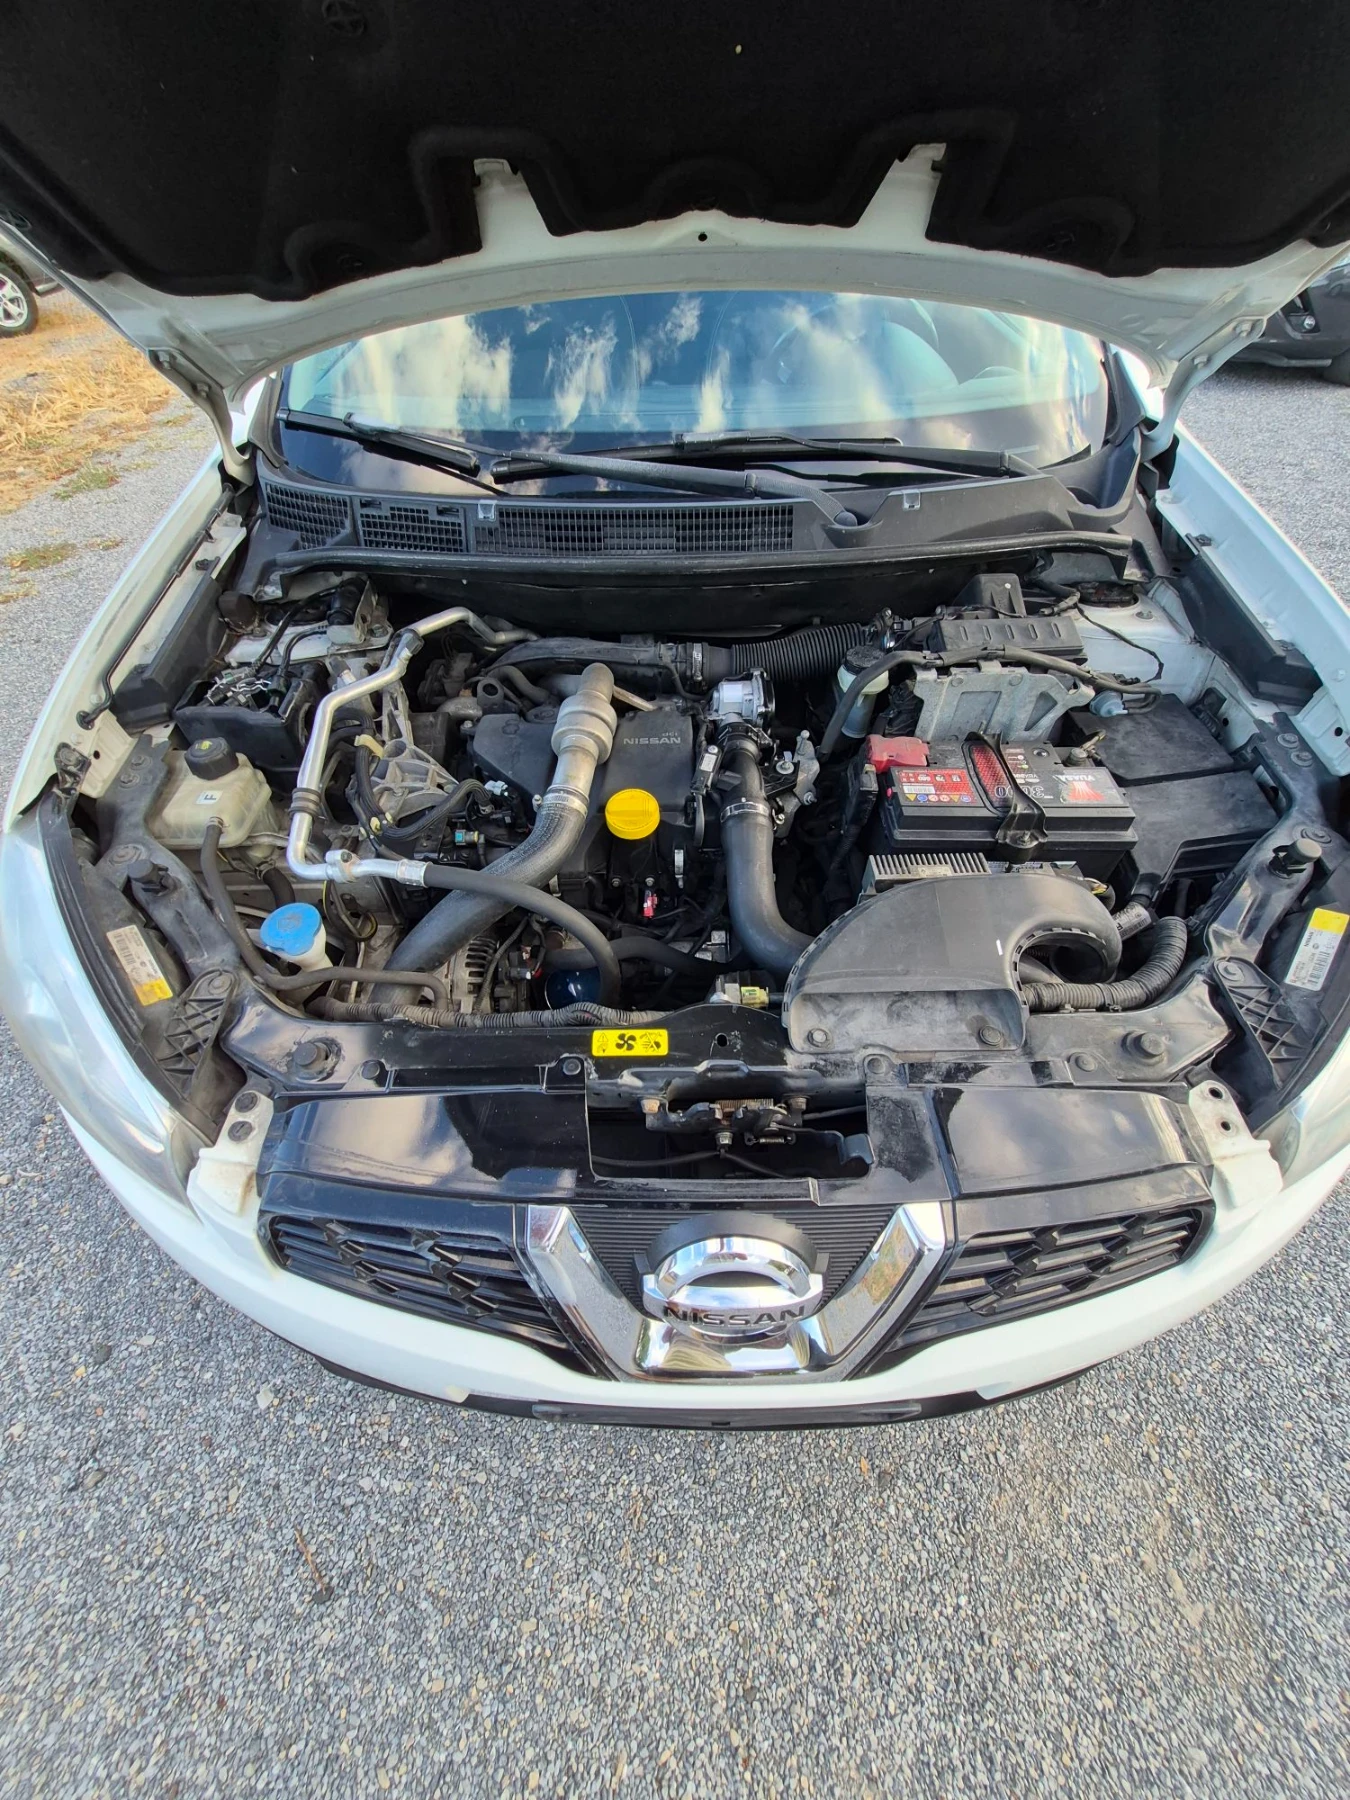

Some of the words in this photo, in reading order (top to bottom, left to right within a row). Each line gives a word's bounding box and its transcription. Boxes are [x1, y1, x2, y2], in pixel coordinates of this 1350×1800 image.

[623, 736, 681, 745] NISSAN
[1053, 774, 1096, 782] YUASA
[663, 1305, 805, 1327] NISSAN
